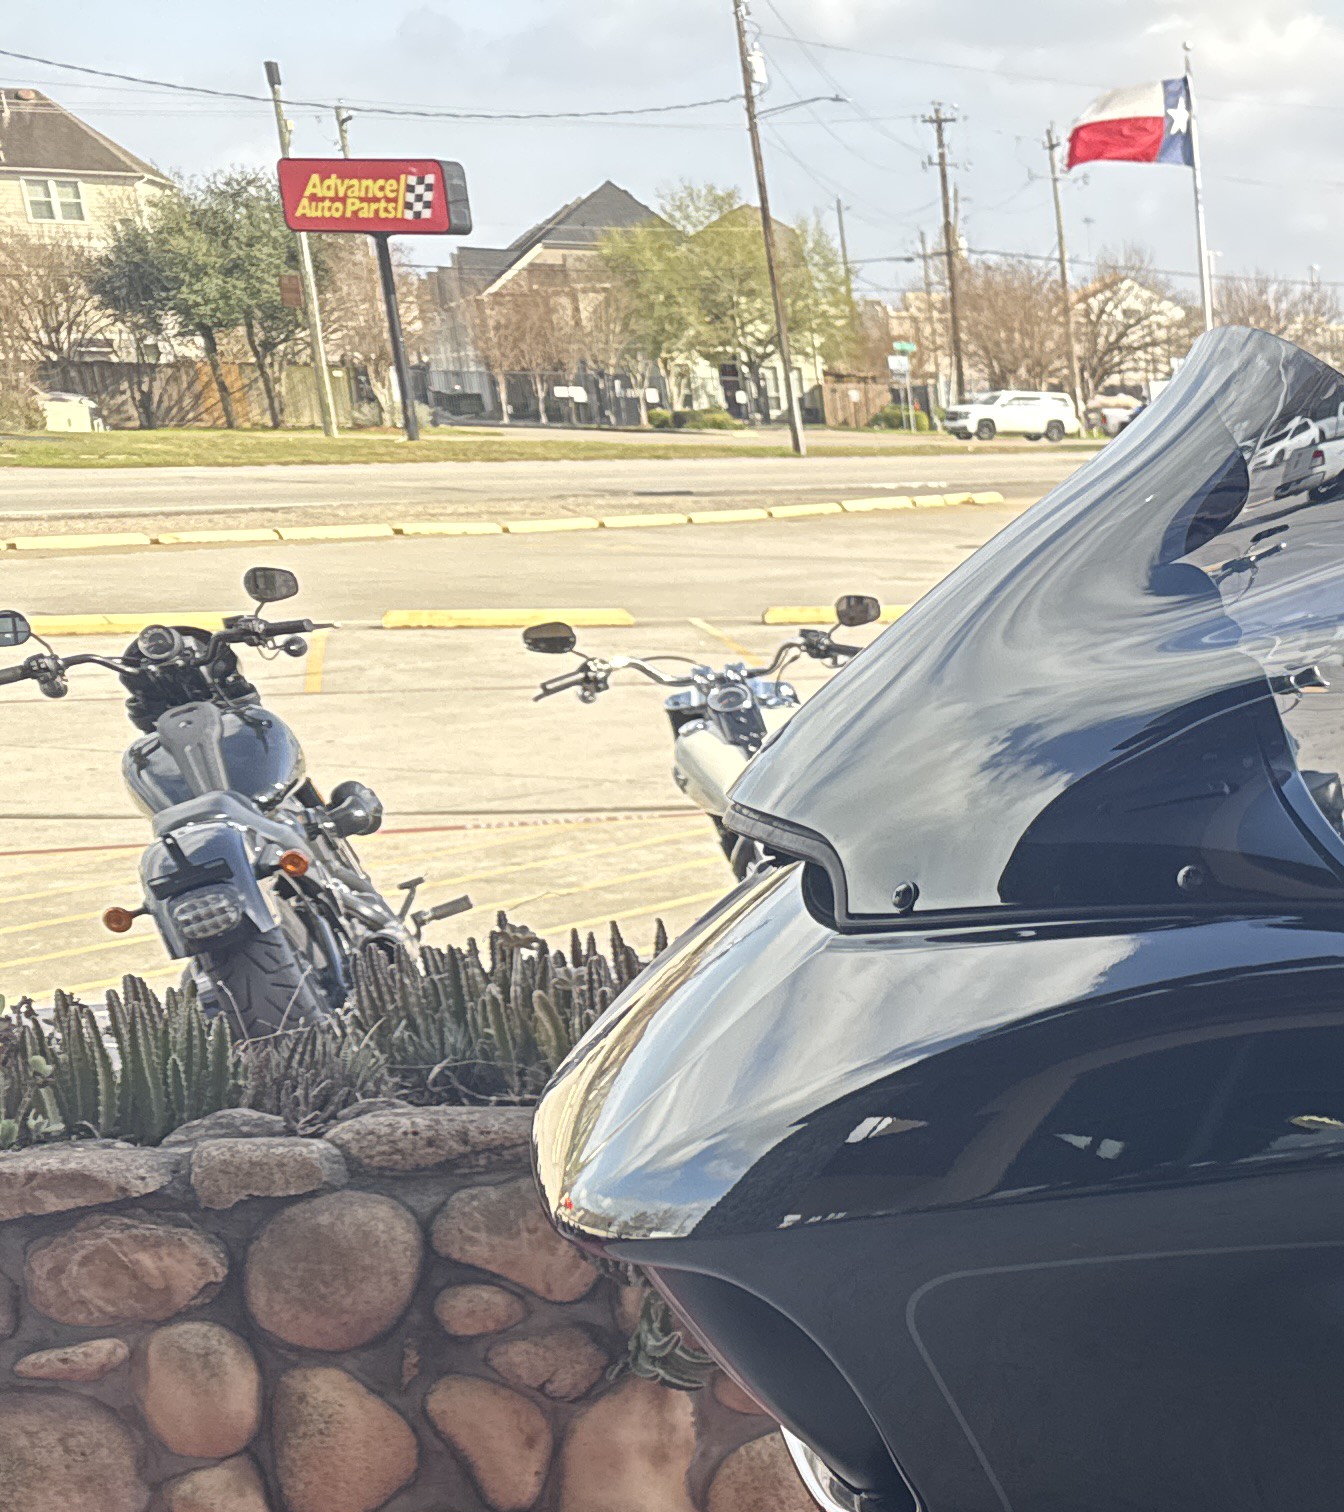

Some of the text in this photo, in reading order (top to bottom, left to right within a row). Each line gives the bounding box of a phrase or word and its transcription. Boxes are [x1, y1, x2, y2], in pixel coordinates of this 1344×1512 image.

[303, 173, 398, 198] Advance
[295, 197, 397, 218] Auto Parts
